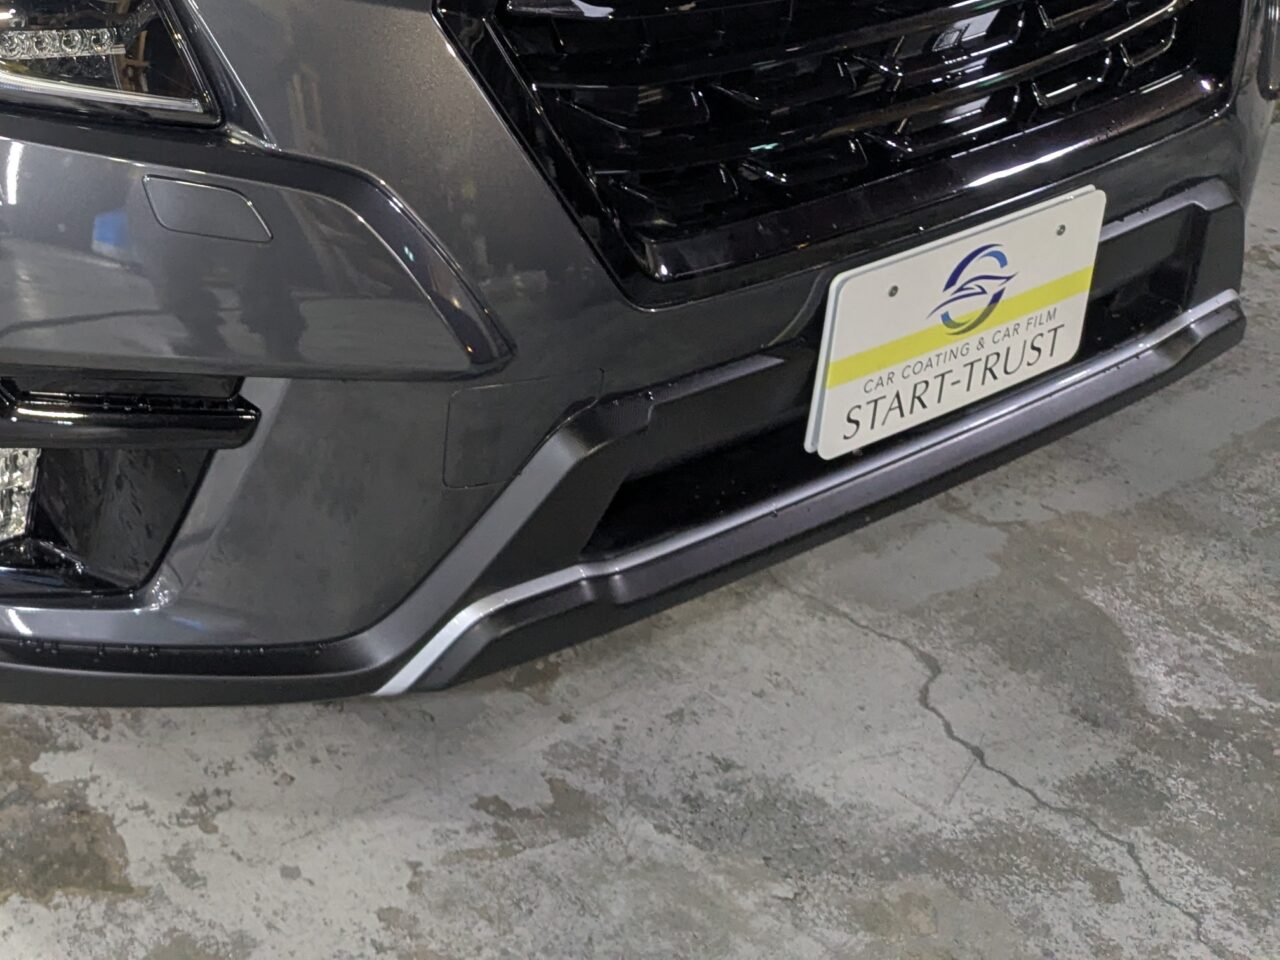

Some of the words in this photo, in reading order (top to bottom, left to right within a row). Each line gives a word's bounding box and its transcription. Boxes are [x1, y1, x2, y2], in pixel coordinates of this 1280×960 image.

[842, 324, 1065, 440] START-TRUST
[863, 371, 895, 394] CAR
[901, 343, 970, 380] COATING
[976, 337, 985, 351] &
[992, 323, 1021, 345] CAR
[1026, 307, 1057, 331] FILM
